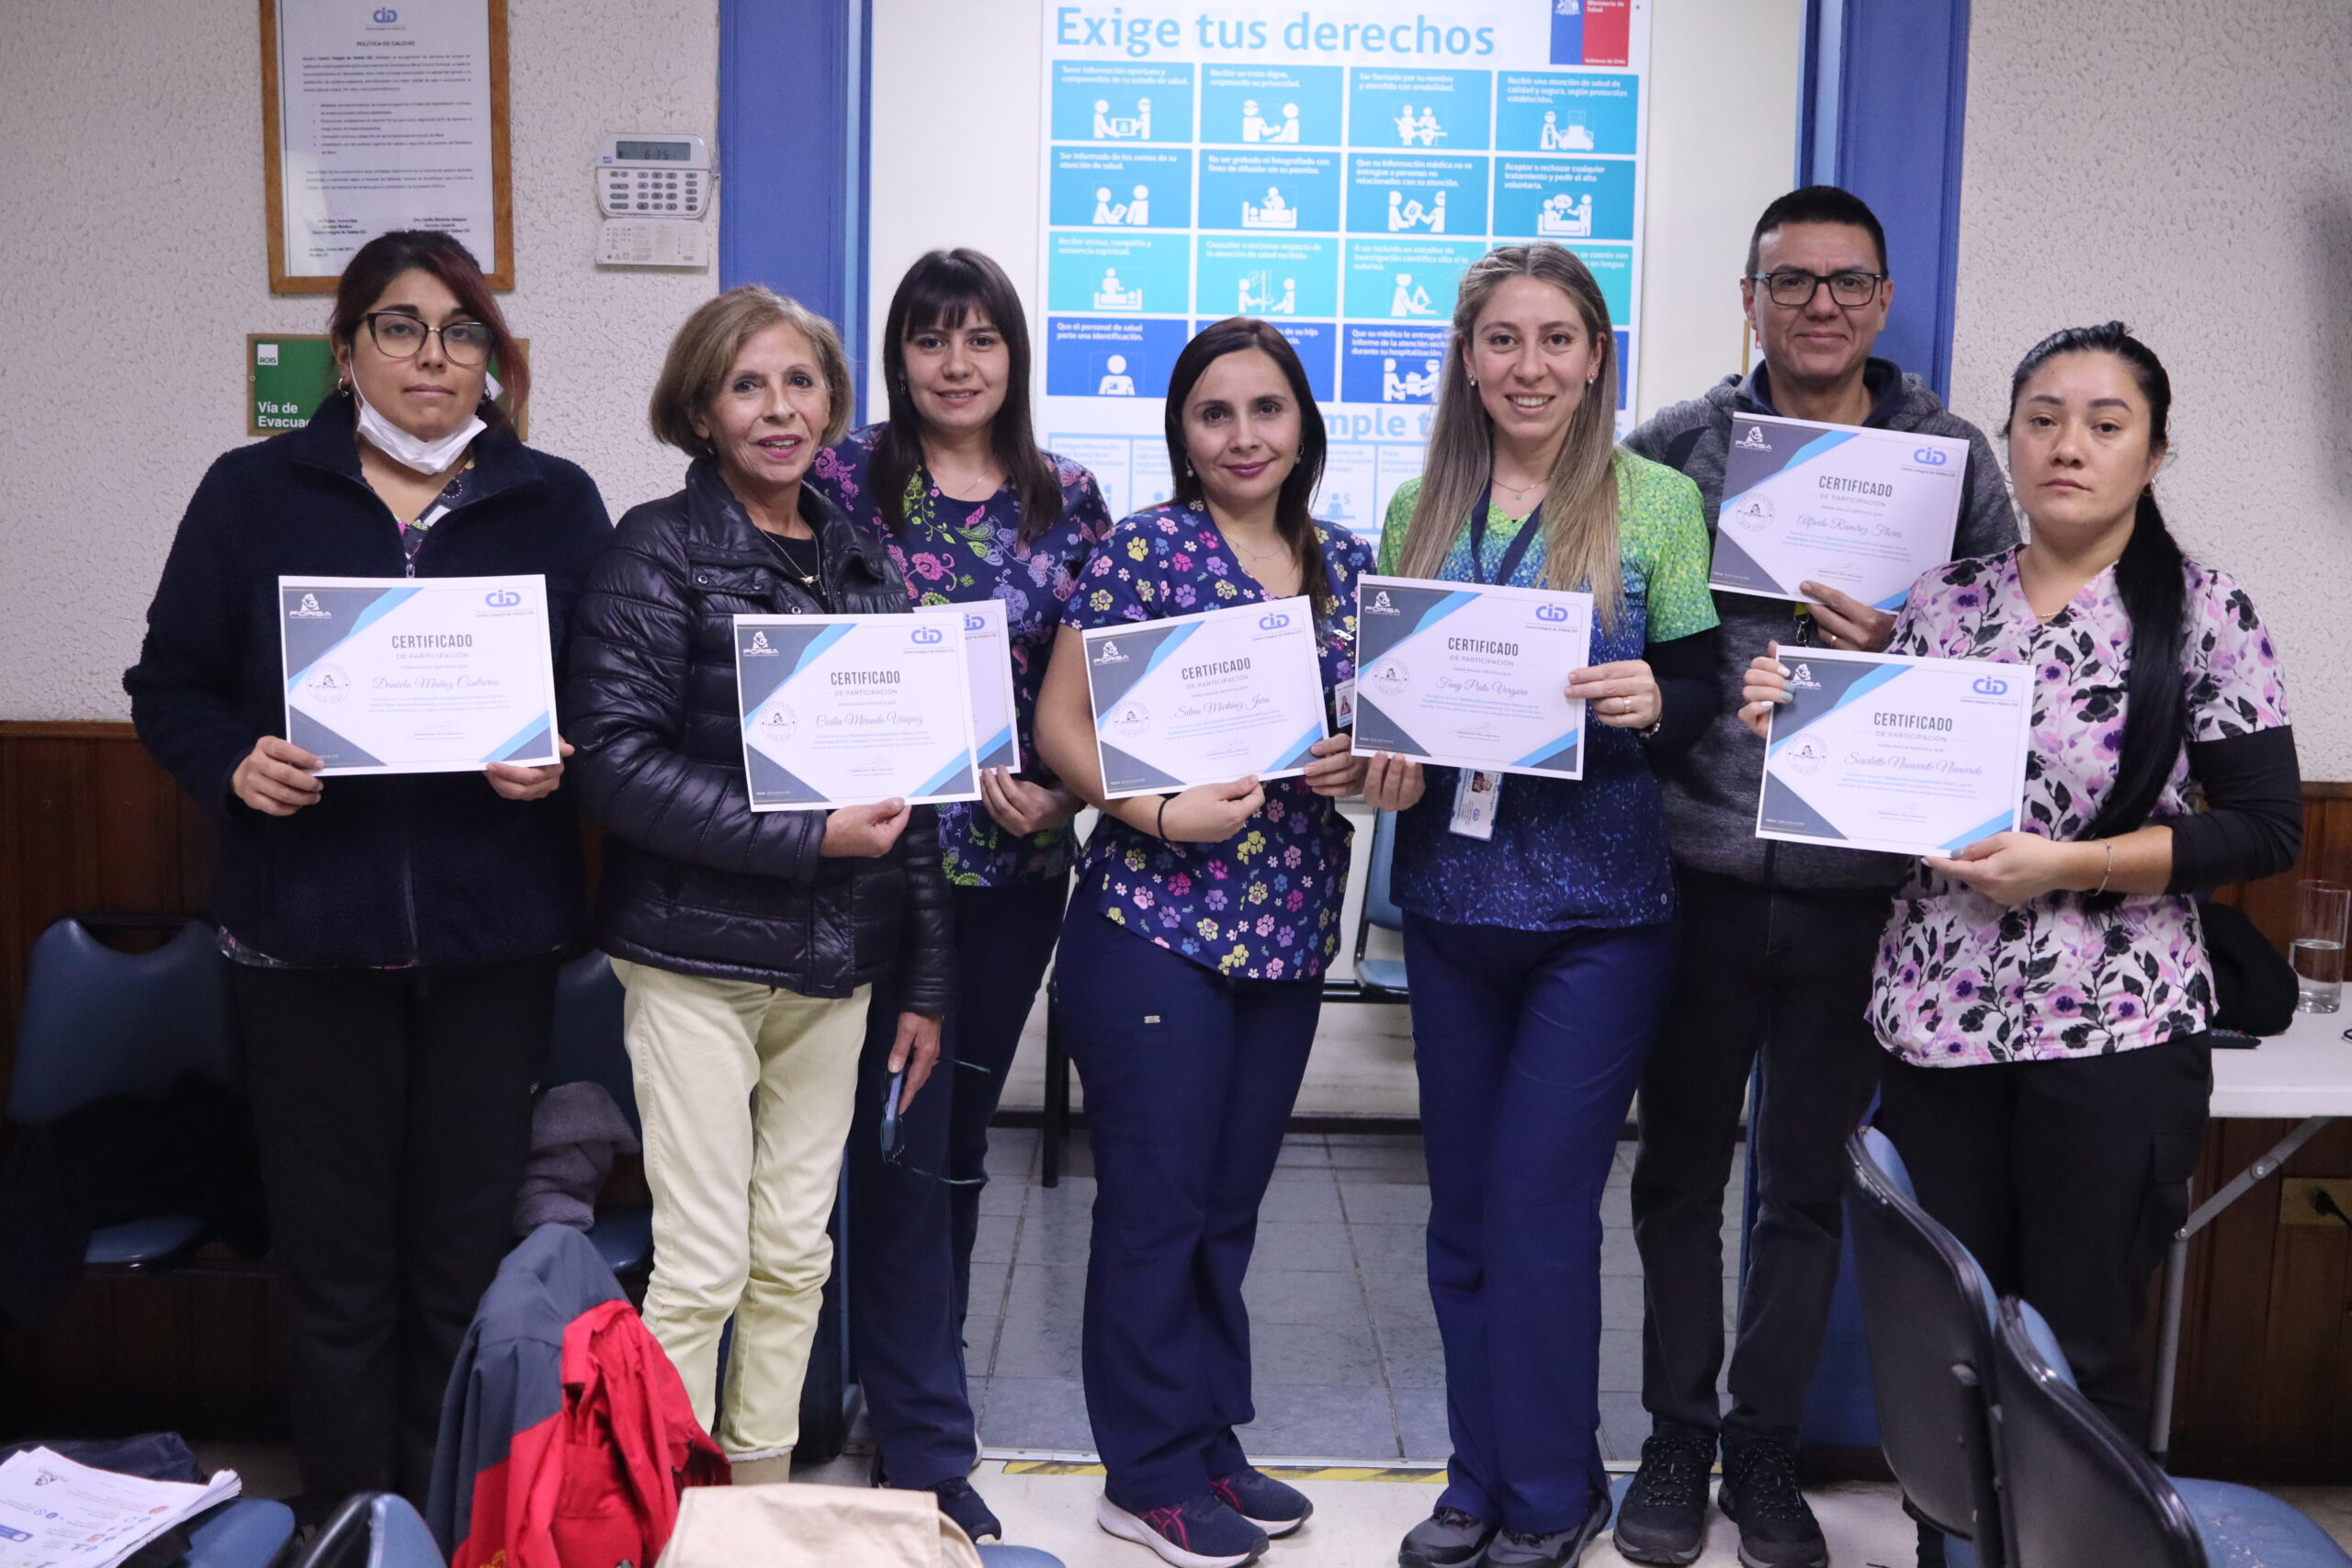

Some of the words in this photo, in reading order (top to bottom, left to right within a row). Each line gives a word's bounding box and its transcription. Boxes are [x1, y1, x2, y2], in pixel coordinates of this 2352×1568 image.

[1057, 6, 1181, 58] Exige
[1196, 13, 1268, 51] tus
[1283, 12, 1496, 56] derechos
[1504, 162, 1533, 173] Aceptar
[1540, 164, 1570, 172] rechazar
[1572, 164, 1606, 175] cualquier
[1504, 173, 1548, 182] tratamiento
[1548, 175, 1554, 184] y
[1555, 174, 1573, 183] pedir
[1582, 175, 1598, 183] alta
[1503, 182, 1544, 190] voluntaria.
[1057, 322, 1073, 333] Que
[1073, 322, 1080, 332] el
[1081, 323, 1112, 333] personal
[1113, 323, 1122, 332] de
[1123, 323, 1143, 333] salud
[1284, 327, 1295, 335] de
[1305, 328, 1318, 338] hijo
[257, 401, 278, 413] Vía
[281, 402, 299, 413] de
[1734, 440, 1772, 451] FORSA
[1818, 475, 1894, 498] CERTIFICADO
[289, 610, 332, 618] FORSA
[1364, 605, 1401, 615] FORSA
[391, 634, 473, 649] CERTIFICADO
[1448, 637, 1521, 657] CERTIFICADO
[1093, 654, 1130, 666] FORSA
[1181, 657, 1252, 681] CERTIFICADO
[831, 670, 901, 686] CERTIFICADO
[1791, 680, 1823, 688] ORSA
[1185, 682, 1197, 691] DE
[1873, 711, 1953, 732] CERTIFICADO
